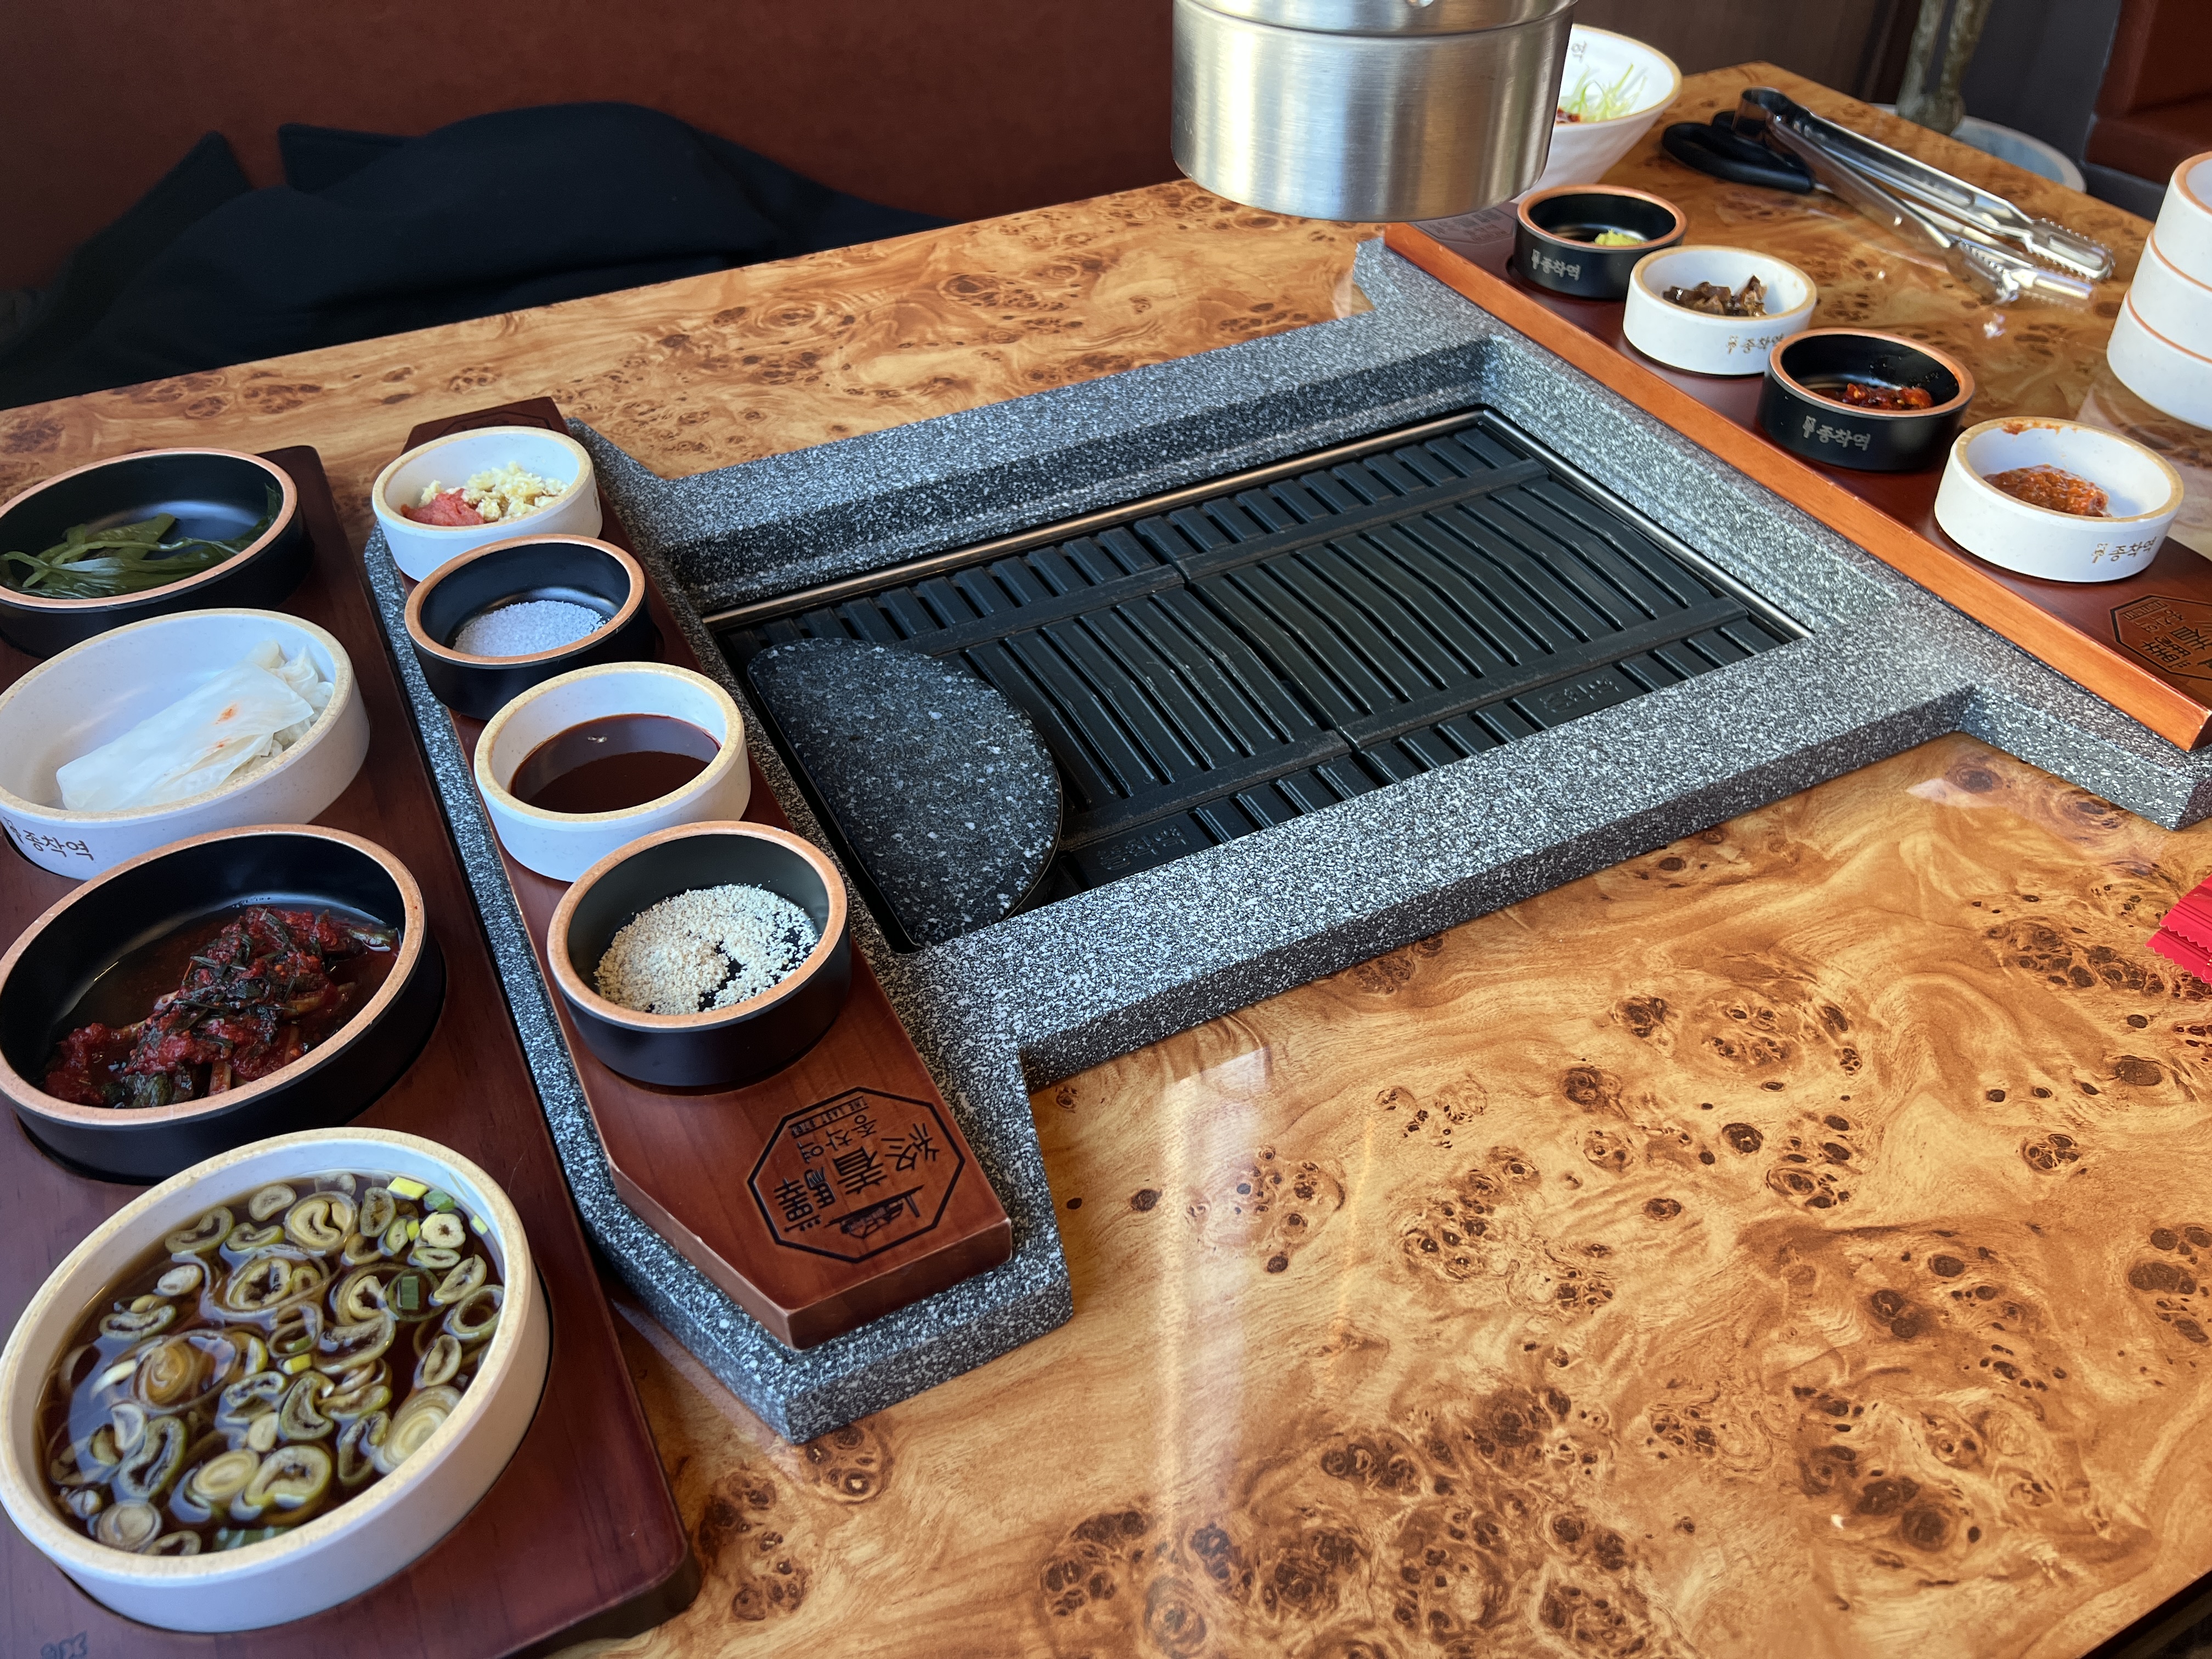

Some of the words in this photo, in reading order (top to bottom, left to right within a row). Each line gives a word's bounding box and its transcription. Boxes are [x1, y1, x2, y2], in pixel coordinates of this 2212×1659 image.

[1541, 256, 1581, 281] 종착역
[1816, 425, 1871, 452] 종착역
[2108, 536, 2157, 562] 종착역
[2134, 610, 2183, 634] 종착역
[23, 830, 94, 861] 종착역
[797, 1114, 877, 1164] 종착역
